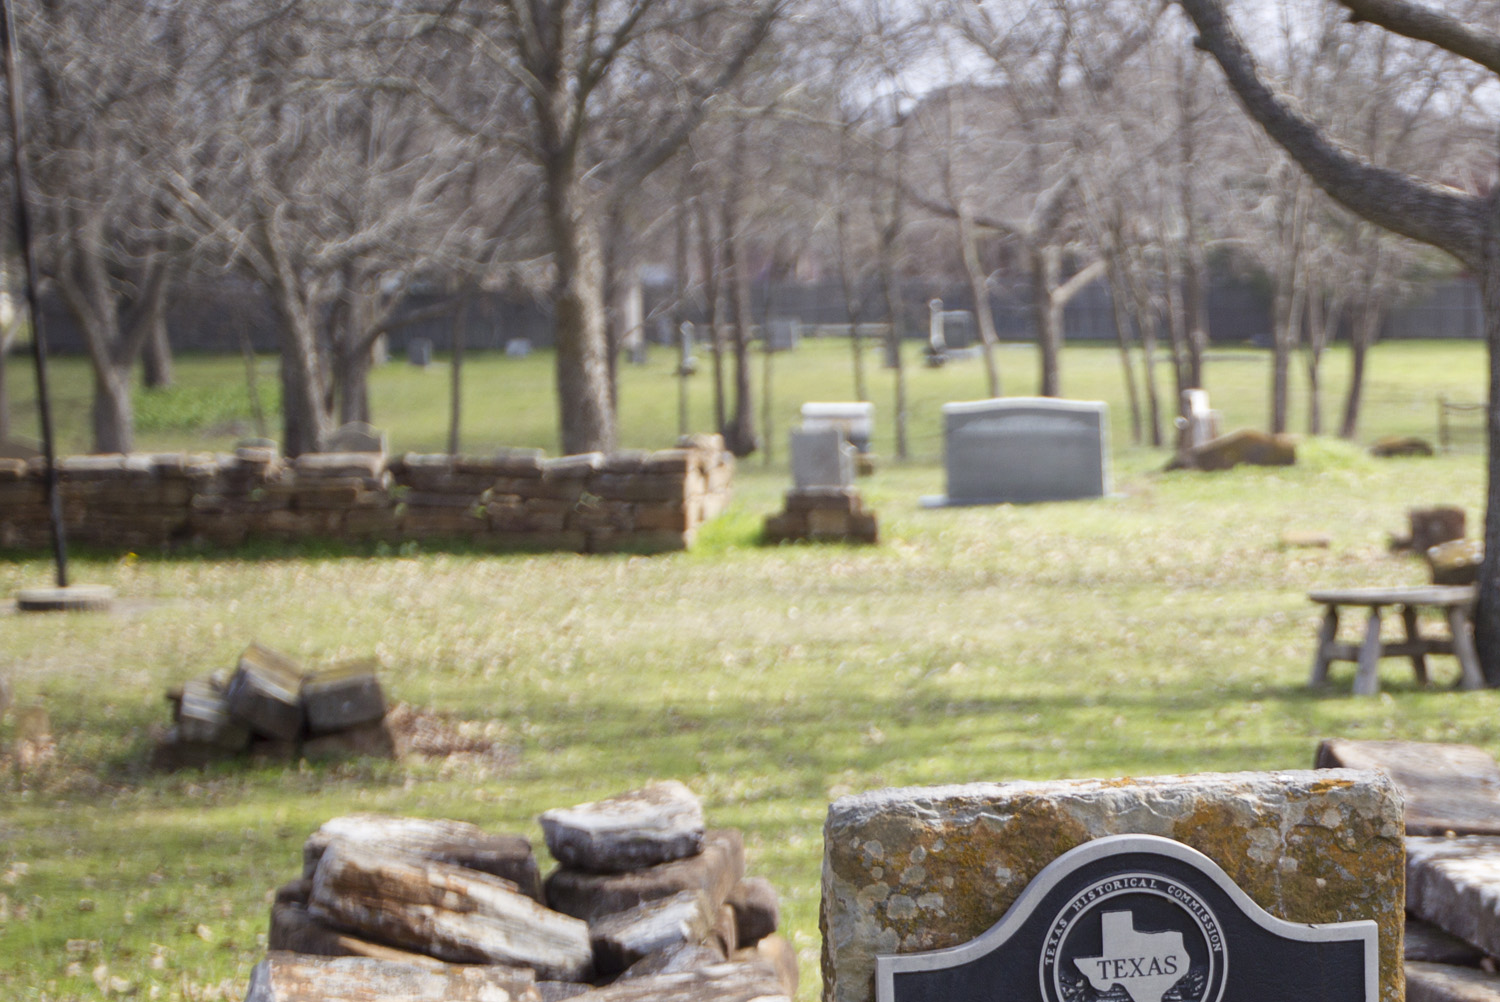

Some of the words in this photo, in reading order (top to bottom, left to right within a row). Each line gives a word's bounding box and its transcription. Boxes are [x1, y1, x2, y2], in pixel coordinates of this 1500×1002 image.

[1044, 917, 1068, 965] TEXAS
[1072, 877, 1158, 912] HISTORICAL
[1167, 885, 1223, 953] COMMISSION
[1096, 955, 1178, 980] TEXAS
